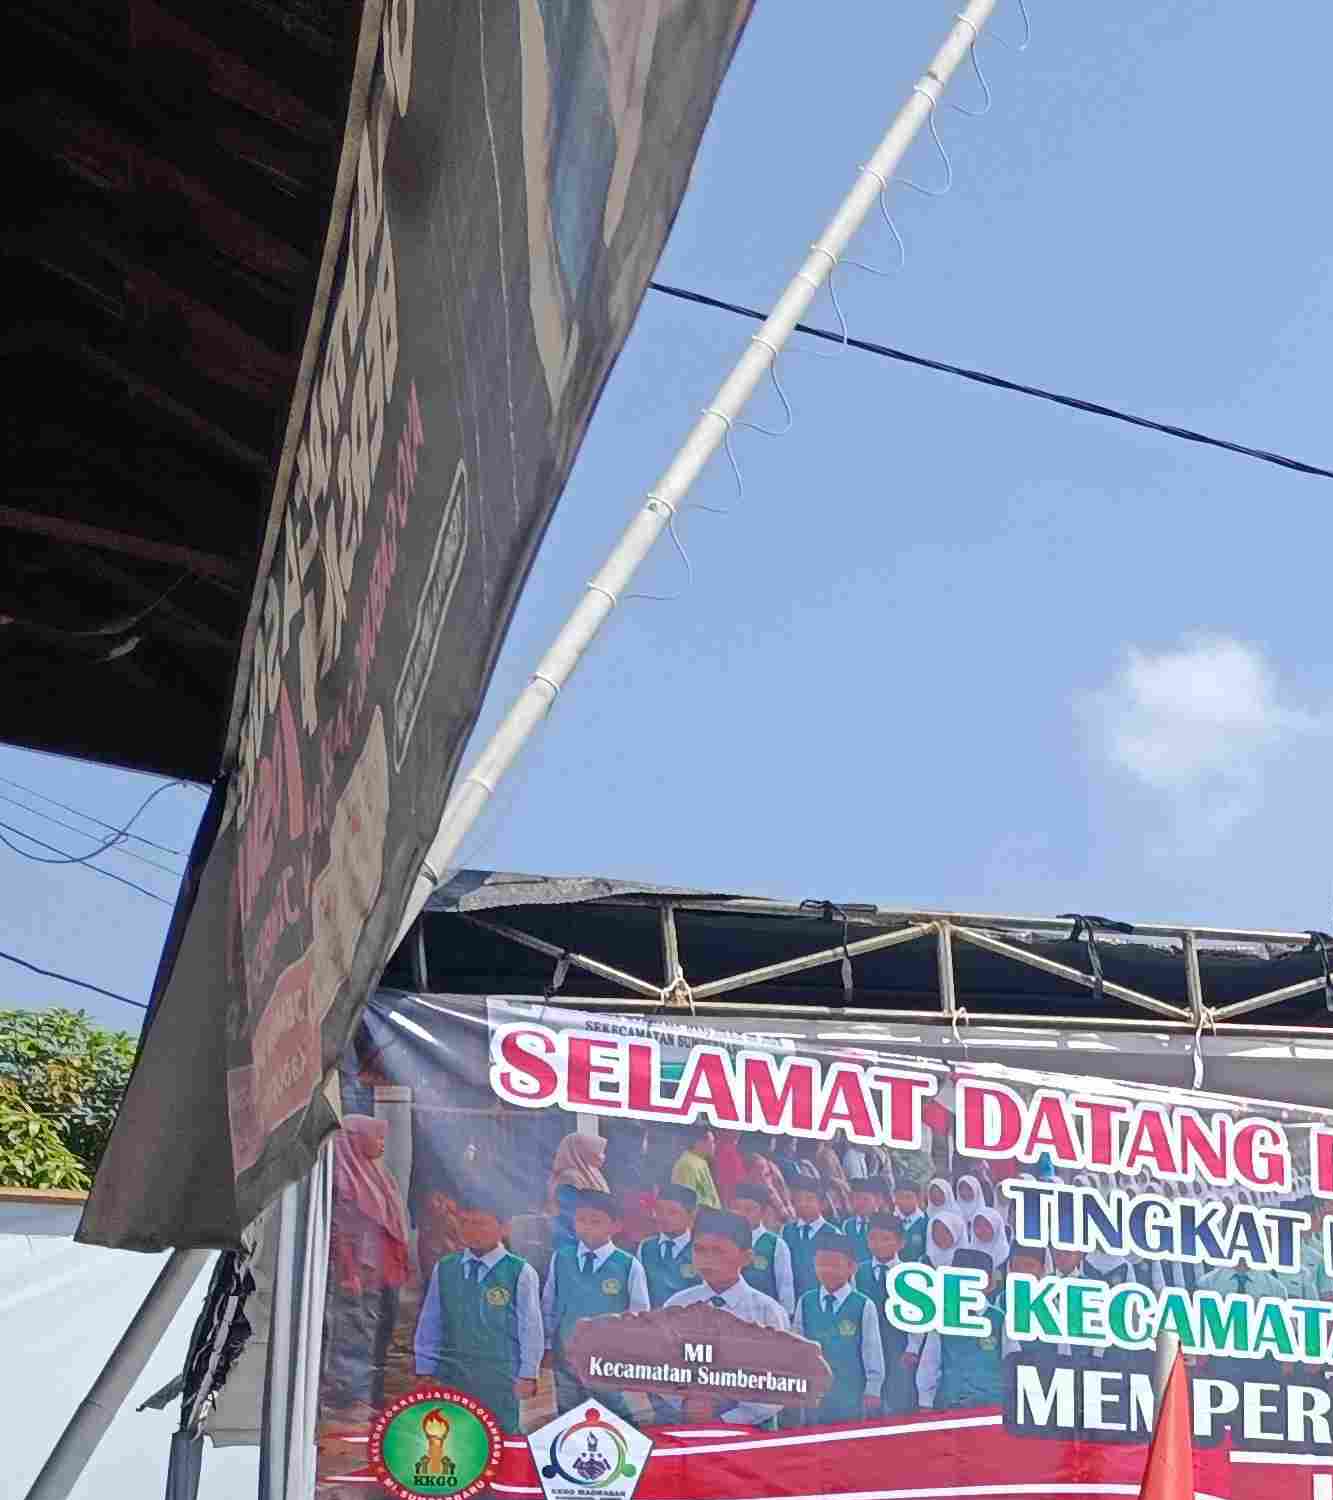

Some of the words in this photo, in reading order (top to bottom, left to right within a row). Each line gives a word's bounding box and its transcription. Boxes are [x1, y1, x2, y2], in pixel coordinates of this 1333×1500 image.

[490, 1022, 931, 1150] SELAMAT
[955, 1076, 1292, 1192] DATANG
[1005, 1180, 1302, 1273] TINGKAT
[885, 1260, 992, 1338] SE
[589, 1355, 695, 1385] Kecamatan
[698, 1364, 810, 1393] Sumberbaru
[683, 1343, 714, 1363] MI
